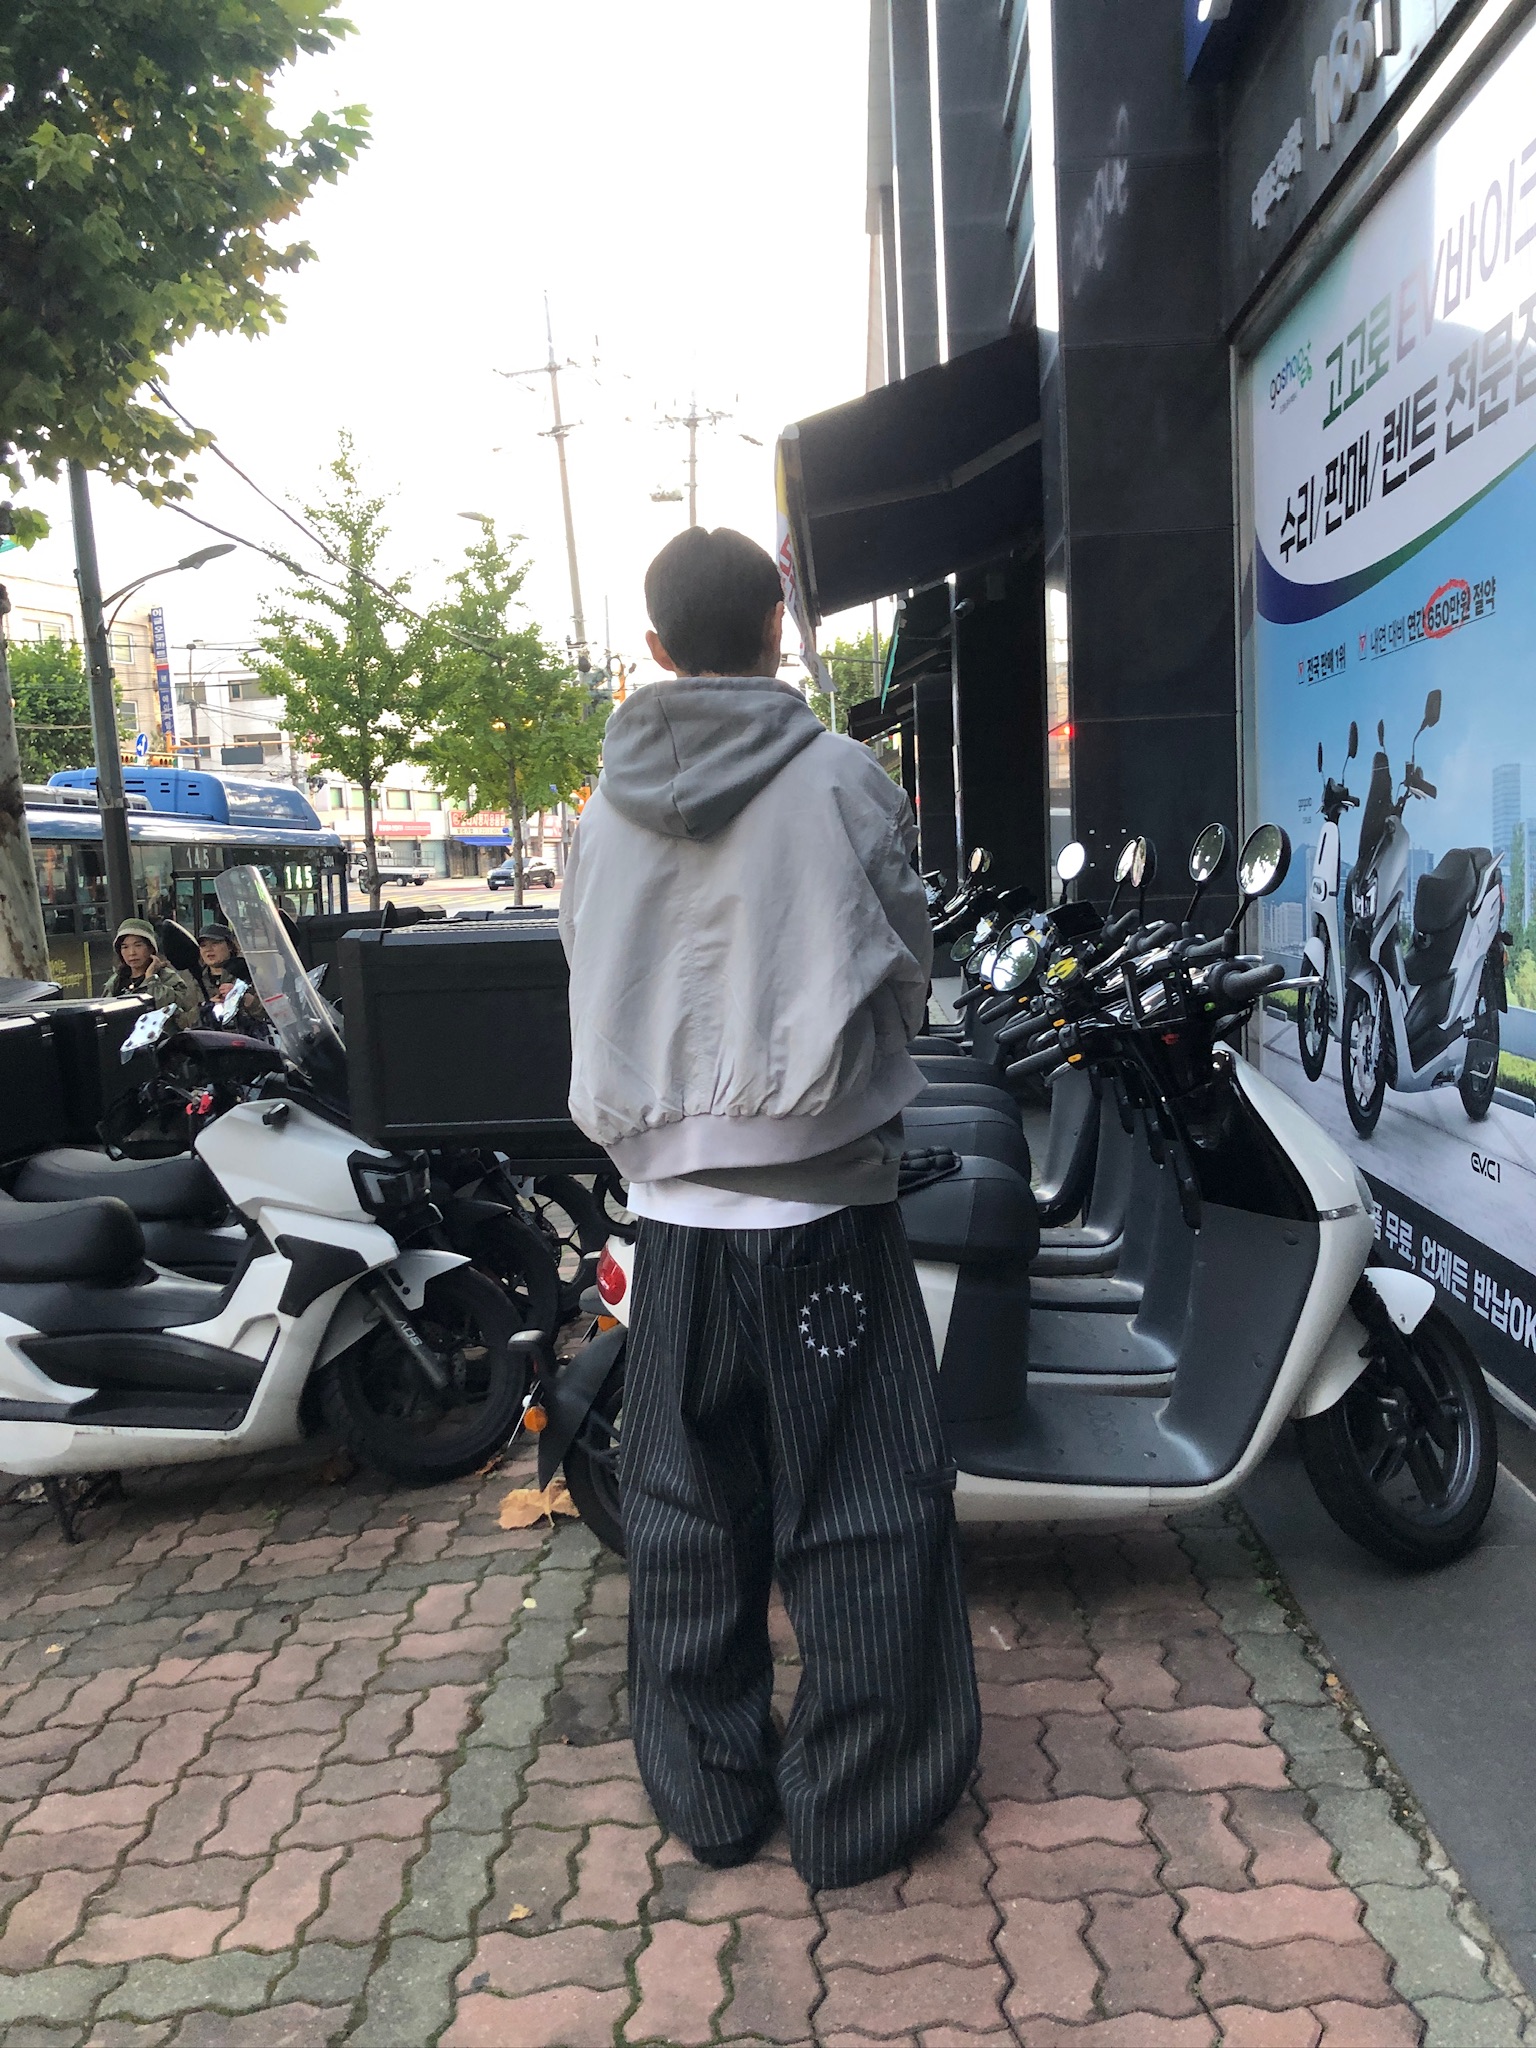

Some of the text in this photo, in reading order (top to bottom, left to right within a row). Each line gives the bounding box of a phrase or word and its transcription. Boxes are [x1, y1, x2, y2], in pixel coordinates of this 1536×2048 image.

[1323, 292, 1392, 431] 고고로
[1473, 576, 1496, 617] 절약
[186, 847, 210, 870] 145
[284, 865, 313, 890] 145
[1385, 1210, 1417, 1270] 무료,
[1421, 1235, 1469, 1304] 언제든
[1473, 1269, 1536, 1355] 반납OK
